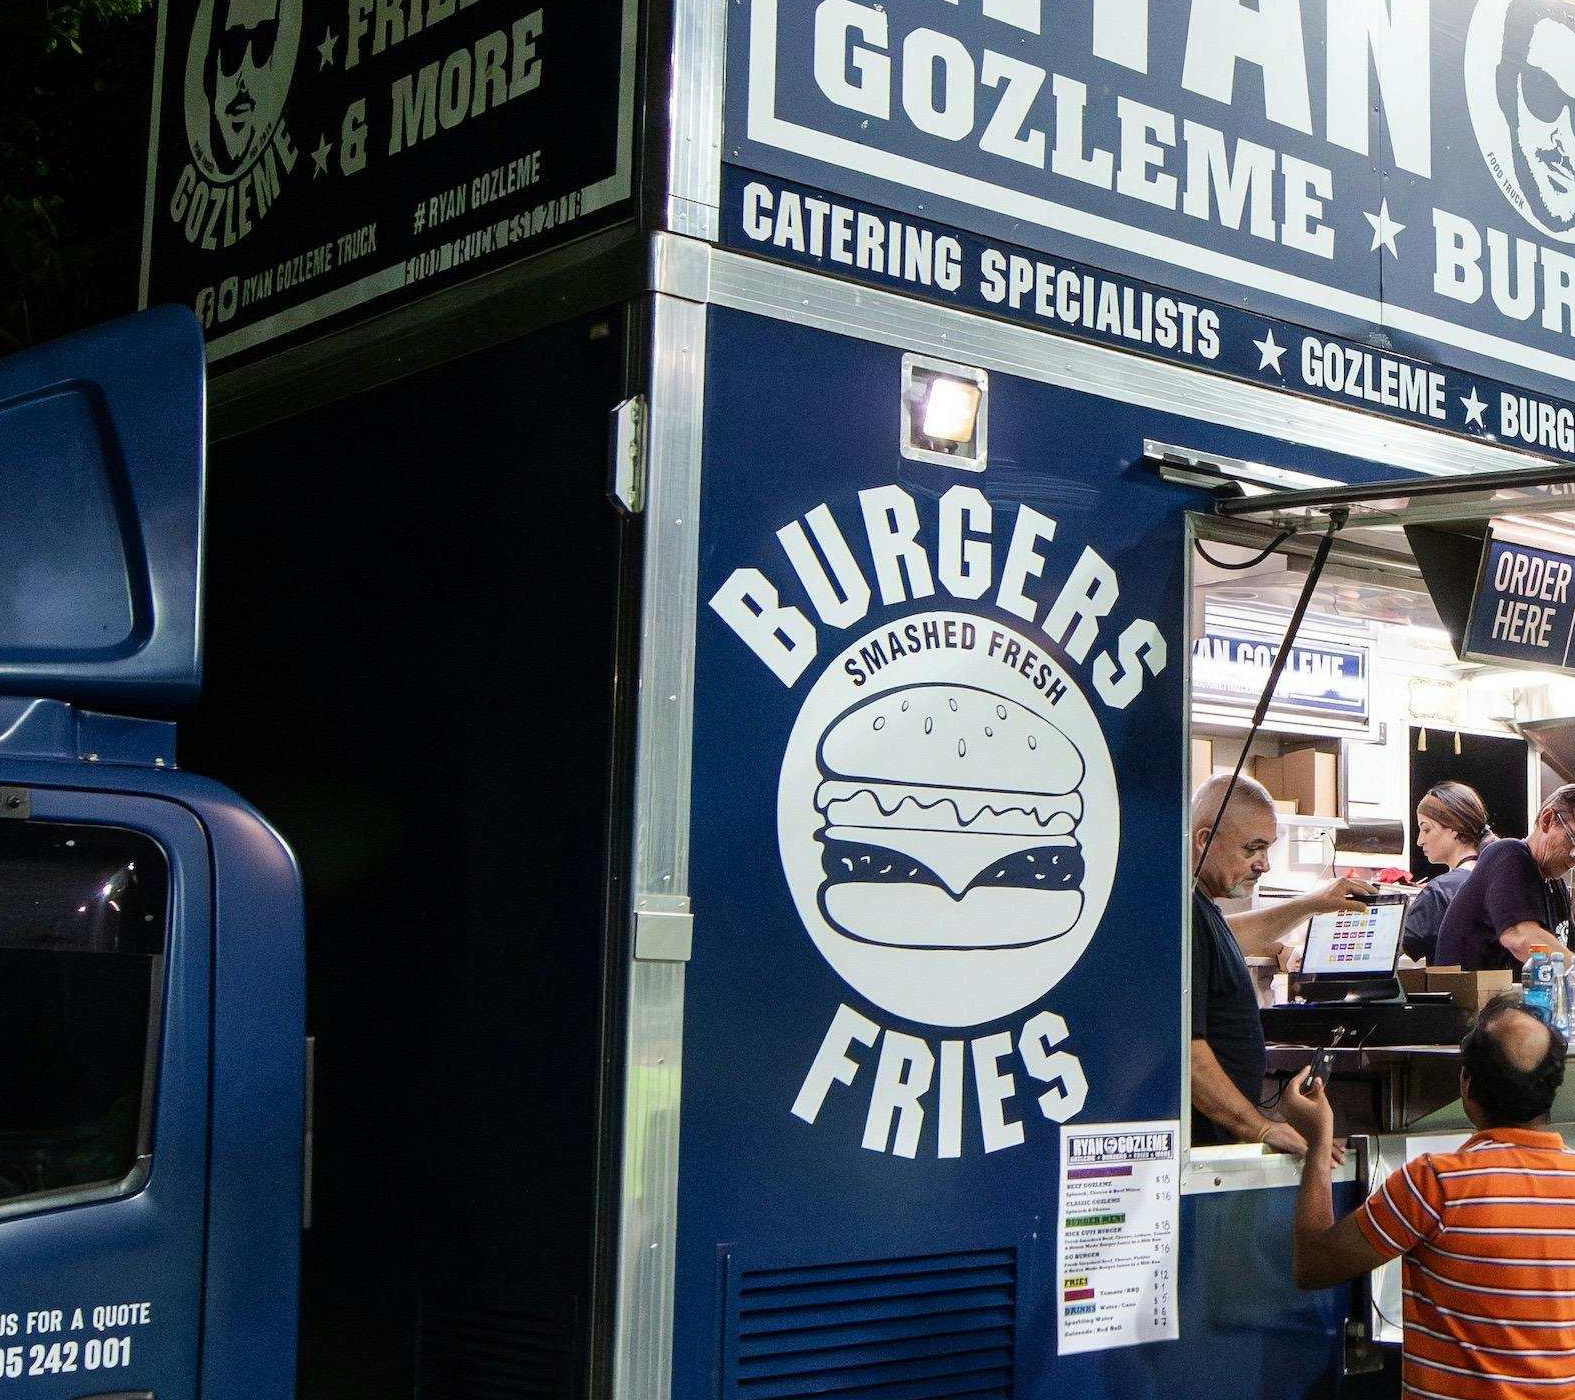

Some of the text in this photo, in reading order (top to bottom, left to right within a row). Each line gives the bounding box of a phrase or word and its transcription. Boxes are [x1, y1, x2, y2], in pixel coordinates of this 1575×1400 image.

[341, 8, 544, 176] & MORE
[170, 119, 299, 251] GOZLEME
[471, 149, 542, 211] GOZLEME
[1486, 151, 1526, 210] FOOD TRUCK
[241, 222, 377, 308] RYAN GOZLEME TRUCK
[741, 182, 962, 292] CATERING
[980, 250, 1222, 358] SPECIALISTS
[1301, 335, 1447, 421] GOZLEME
[707, 483, 1167, 710] BURGERS
[1494, 551, 1572, 605] ORDER
[1192, 637, 1231, 668] AN
[1492, 599, 1557, 650] HERE
[843, 619, 1069, 708] SMASHED FRESH
[790, 1002, 1090, 1160] FRIES
[1073, 1133, 1170, 1157] RYAN GOZLEME
[1065, 1277, 1089, 1288] FRIES
[25, 1308, 62, 1335] FOR
[71, 1307, 85, 1330] A
[92, 1302, 152, 1329] QUOTE
[29, 1342, 79, 1377] 242
[85, 1336, 132, 1371] 001
